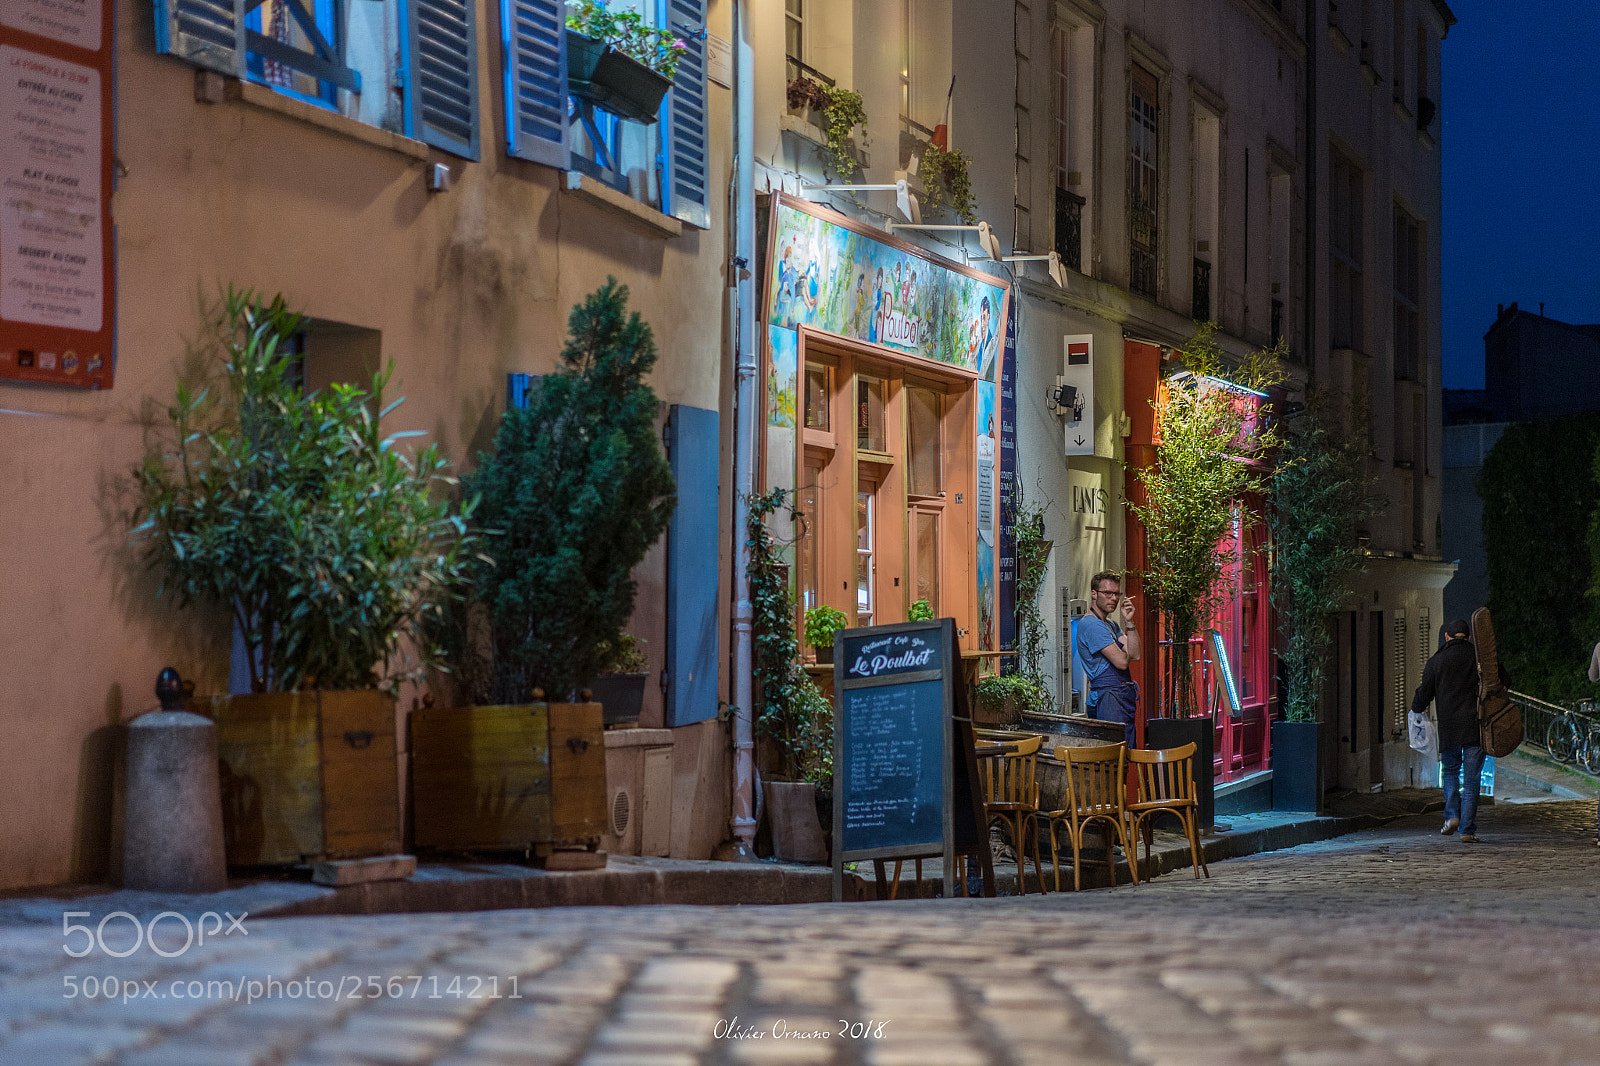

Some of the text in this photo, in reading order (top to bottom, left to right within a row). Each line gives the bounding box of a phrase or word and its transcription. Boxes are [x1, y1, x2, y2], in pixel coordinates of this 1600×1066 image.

[861, 635, 925, 654] Restaurant Café Bar
[849, 648, 935, 676] Le Poulbot
